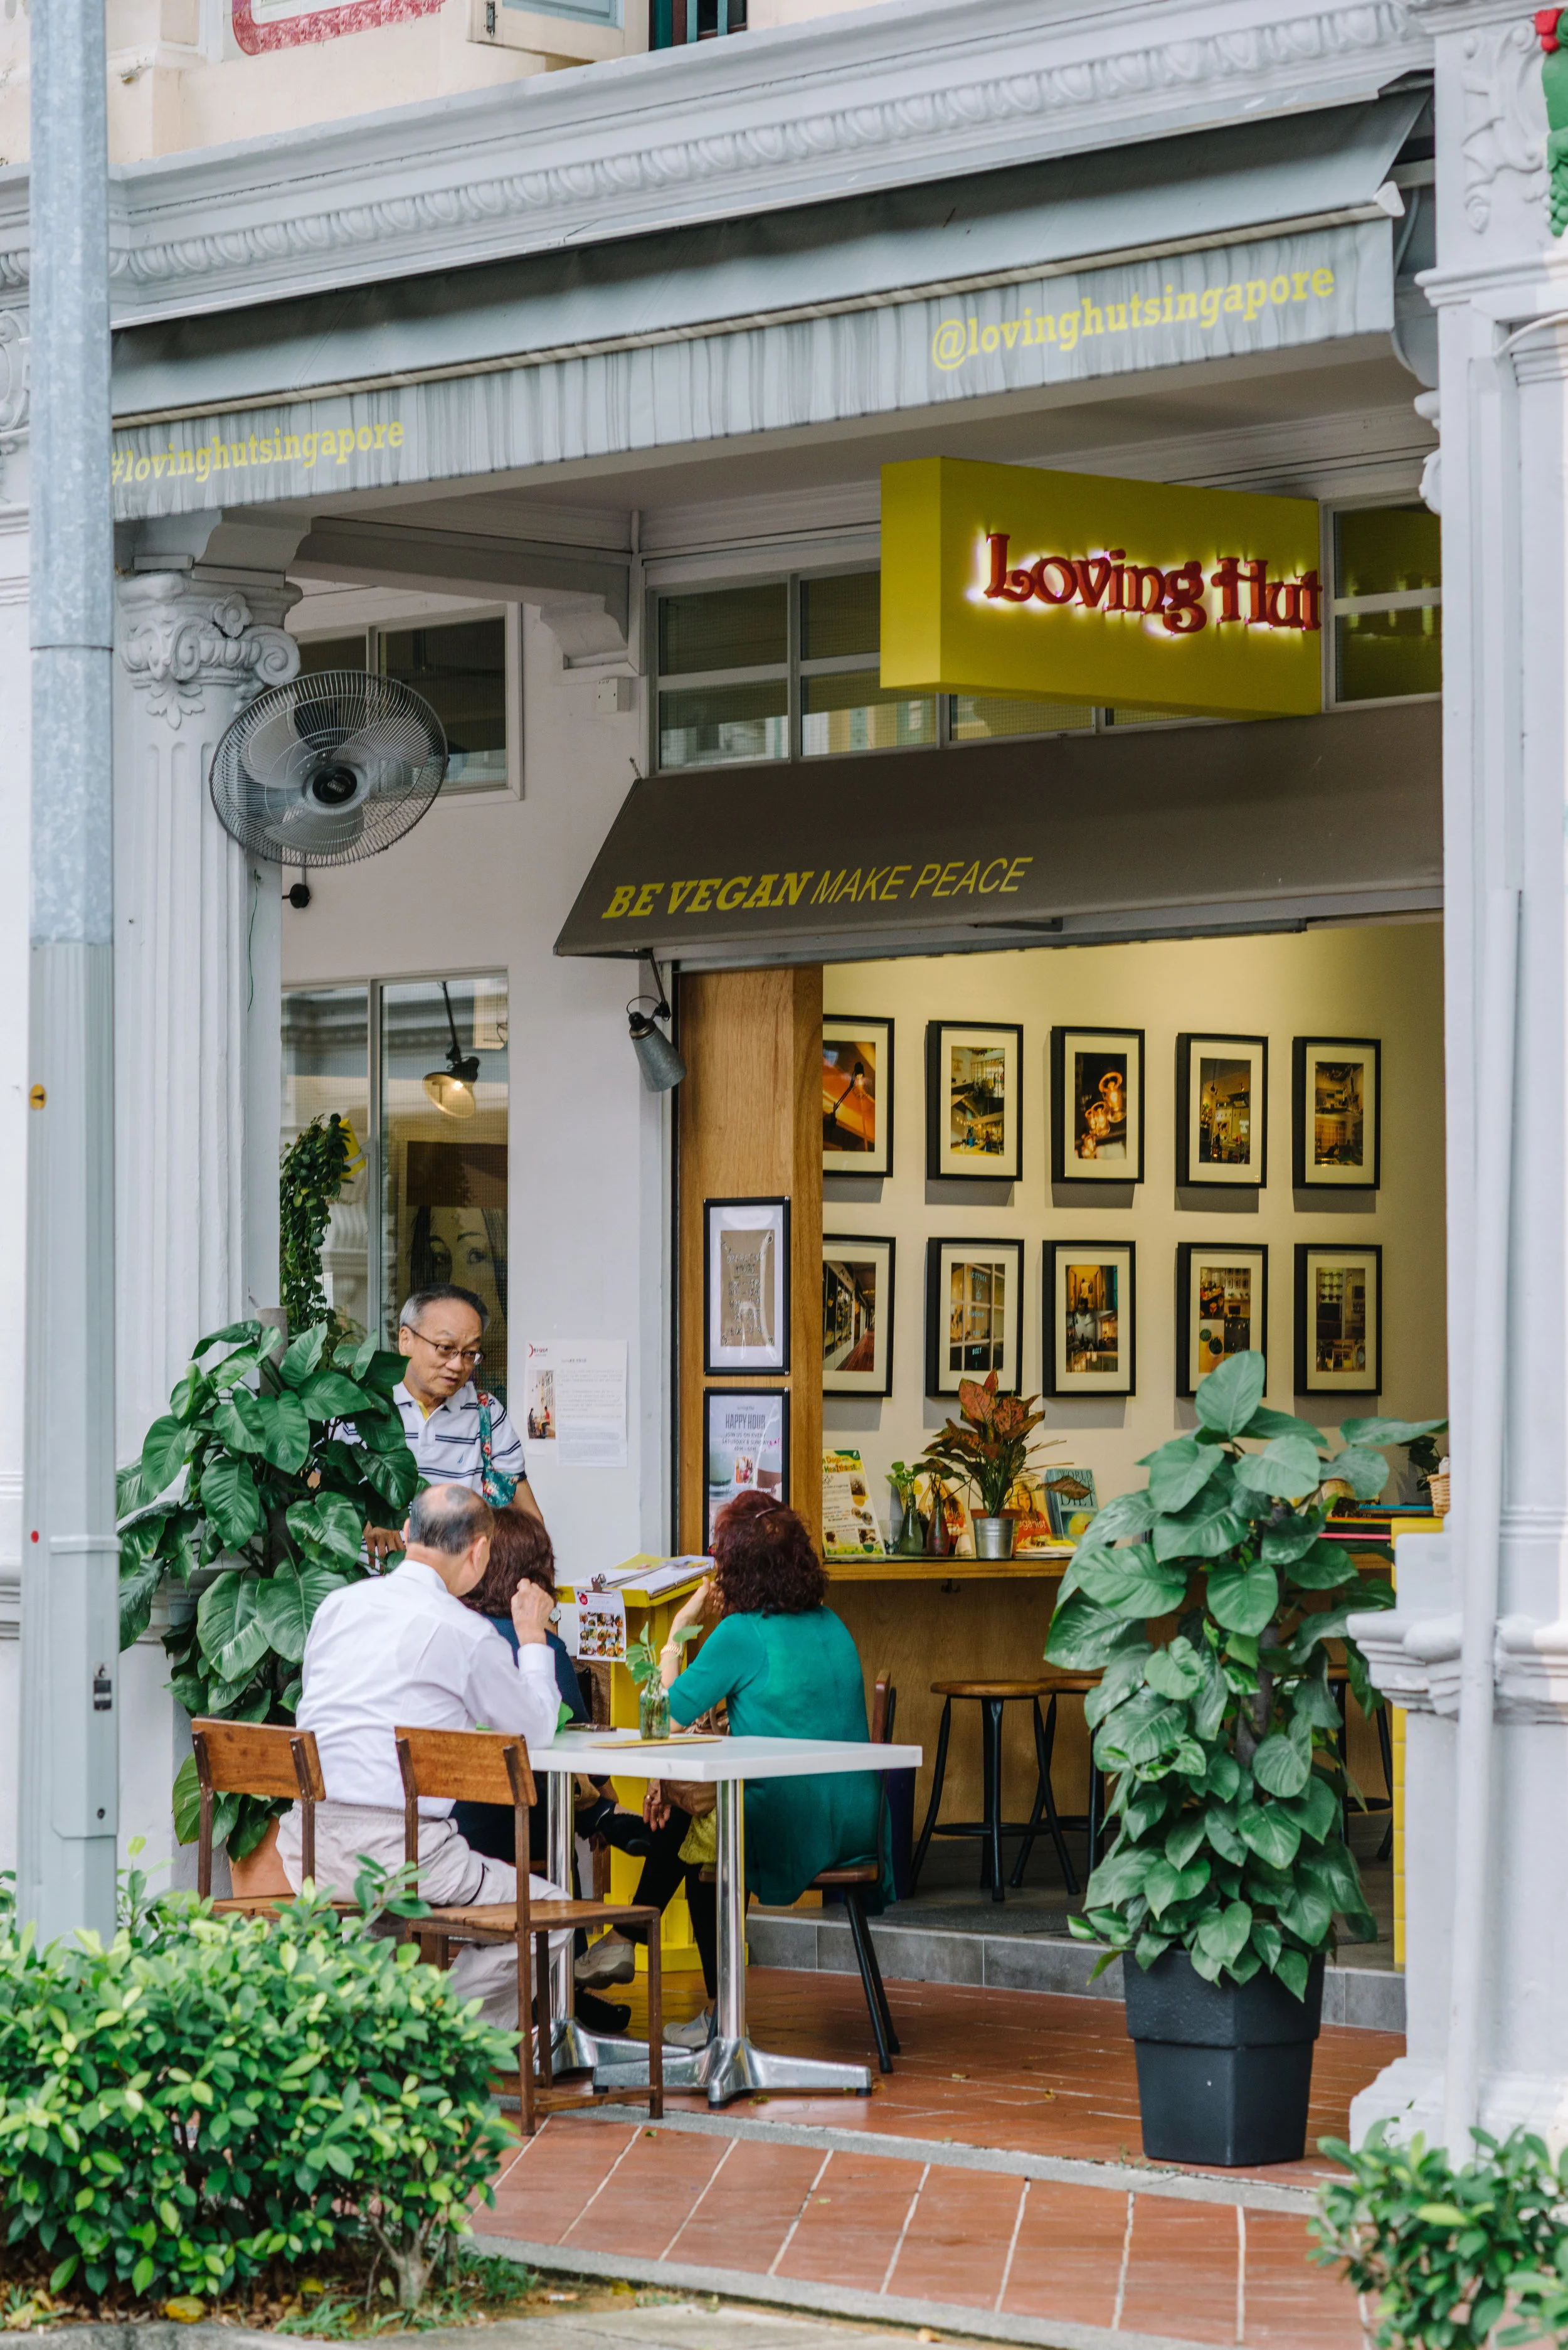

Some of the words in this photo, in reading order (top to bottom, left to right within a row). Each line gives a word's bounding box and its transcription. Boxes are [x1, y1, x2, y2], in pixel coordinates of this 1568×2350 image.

[932, 267, 1335, 371] @lovinghutsingapore
[112, 420, 405, 486] #lovinghutsingapore
[985, 533, 1208, 634] Loving
[1209, 557, 1323, 631] Hut
[601, 883, 663, 919] BE
[667, 871, 814, 915] VEGAN
[810, 865, 912, 904] MAKE
[909, 857, 1034, 898] PEACE
[725, 1413, 746, 1429] HAPPY
[748, 1414, 765, 1430] HOUR
